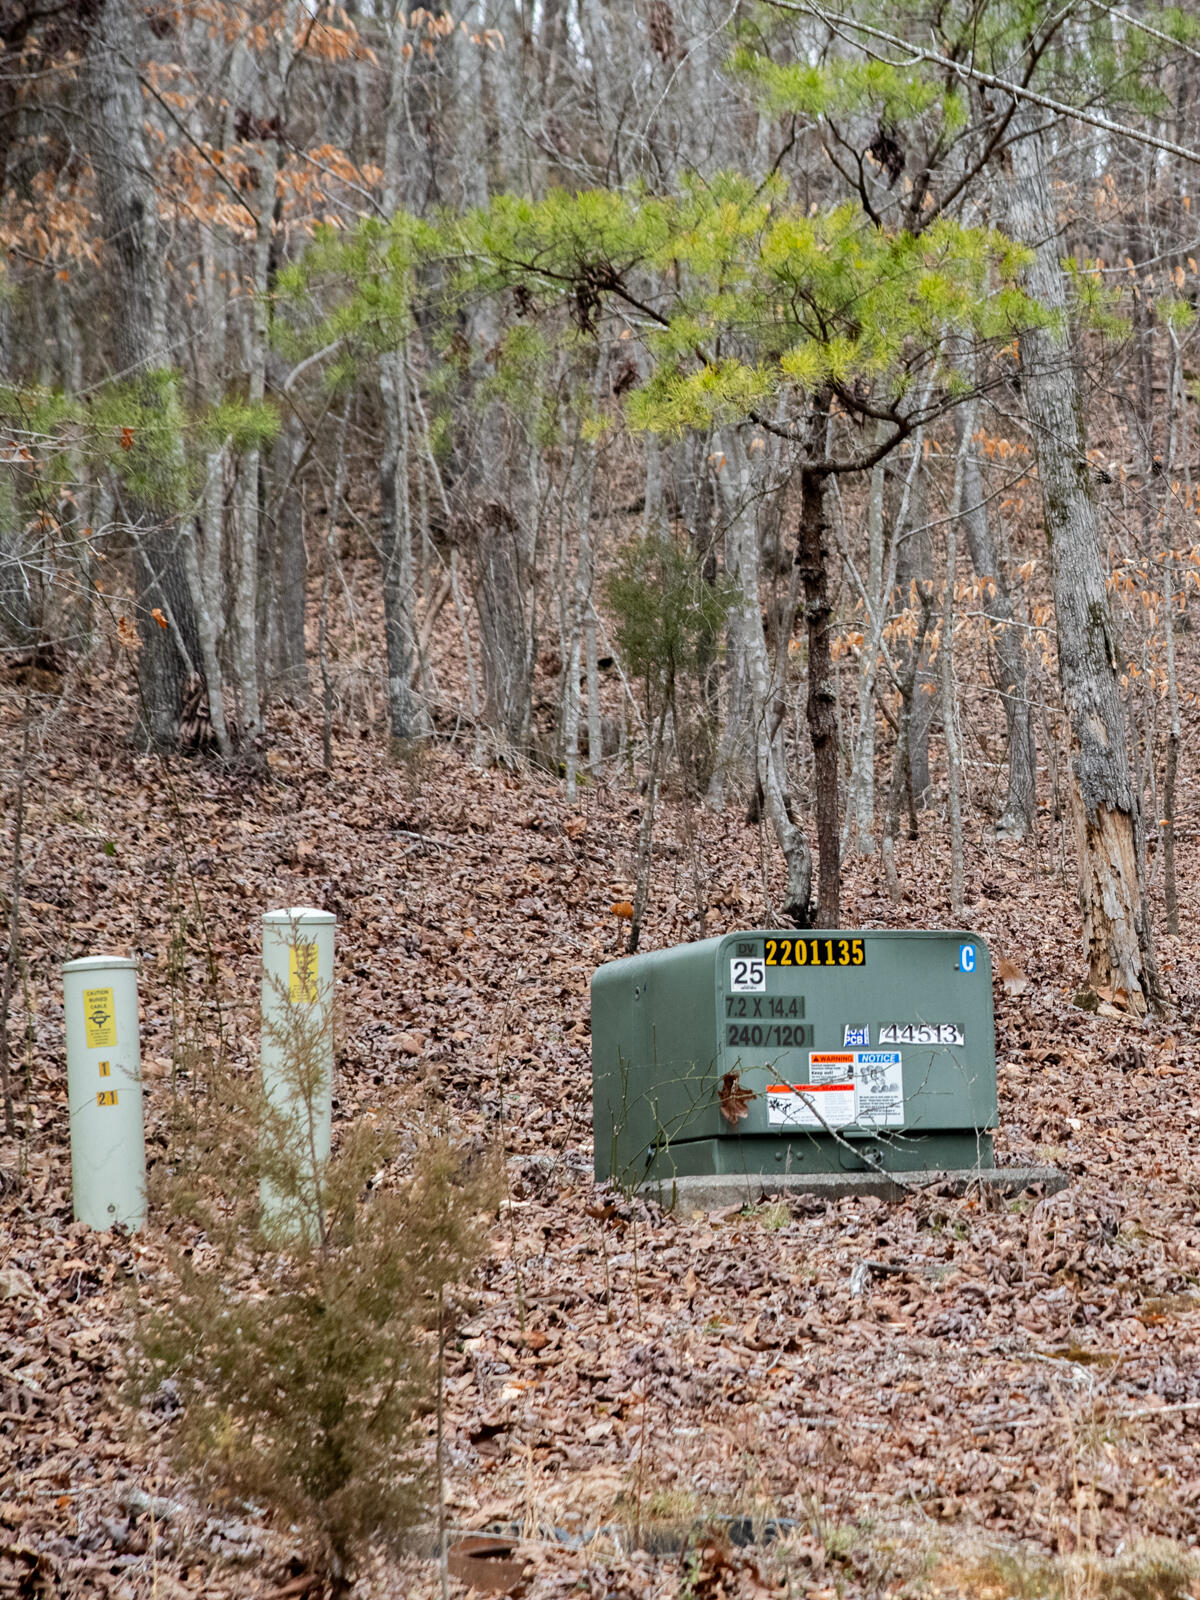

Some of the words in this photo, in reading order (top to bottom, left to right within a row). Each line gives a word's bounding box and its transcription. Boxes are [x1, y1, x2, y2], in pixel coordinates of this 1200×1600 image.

[738, 944, 755, 953] DV
[765, 940, 864, 965] 2201135
[962, 946, 974, 971] C
[733, 961, 764, 985] 25
[726, 997, 747, 1017] 7.2
[753, 997, 762, 1017] X
[769, 997, 798, 1017] 14.4
[728, 1024, 805, 1047] 240/120
[884, 1024, 957, 1043] 44513
[820, 1055, 853, 1063] WARNING
[862, 1054, 896, 1063] NOTICE
[99, 1091, 115, 1105] 21
